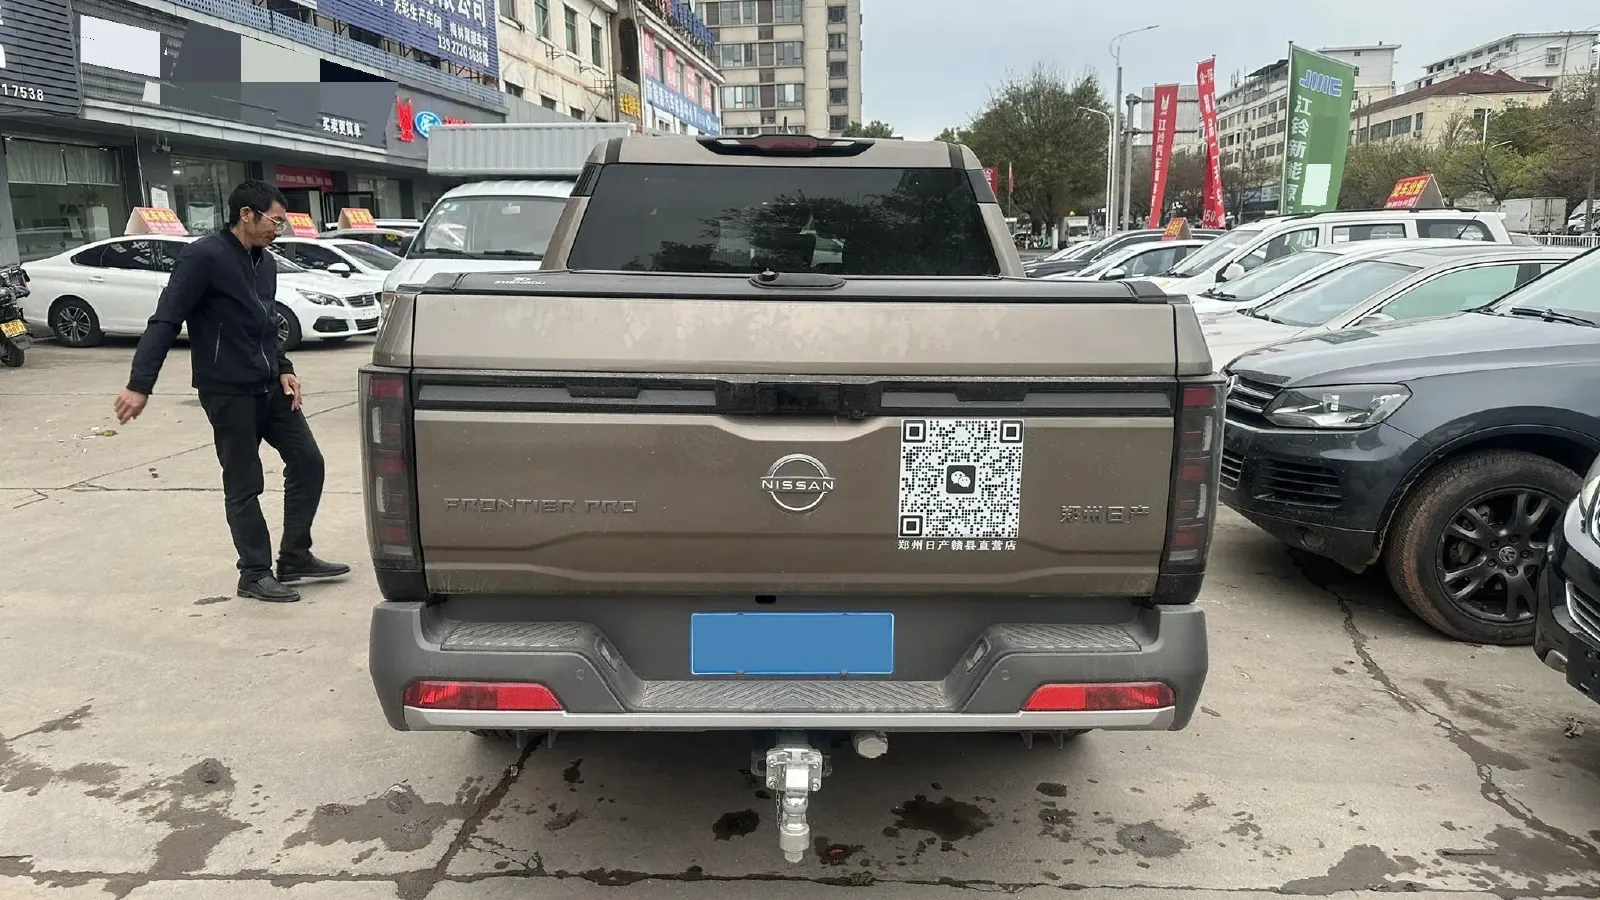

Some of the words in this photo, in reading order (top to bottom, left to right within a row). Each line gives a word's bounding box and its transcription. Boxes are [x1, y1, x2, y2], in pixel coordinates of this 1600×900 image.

[1299, 69, 1343, 97] JMC
[2, 83, 44, 101] 17538
[762, 480, 834, 490] NISSAN
[444, 498, 576, 513] FRONTIER
[585, 499, 637, 513] PRO
[1060, 504, 1150, 523] 郑州日产
[898, 540, 1018, 551] 郑州日产赣县直营店
